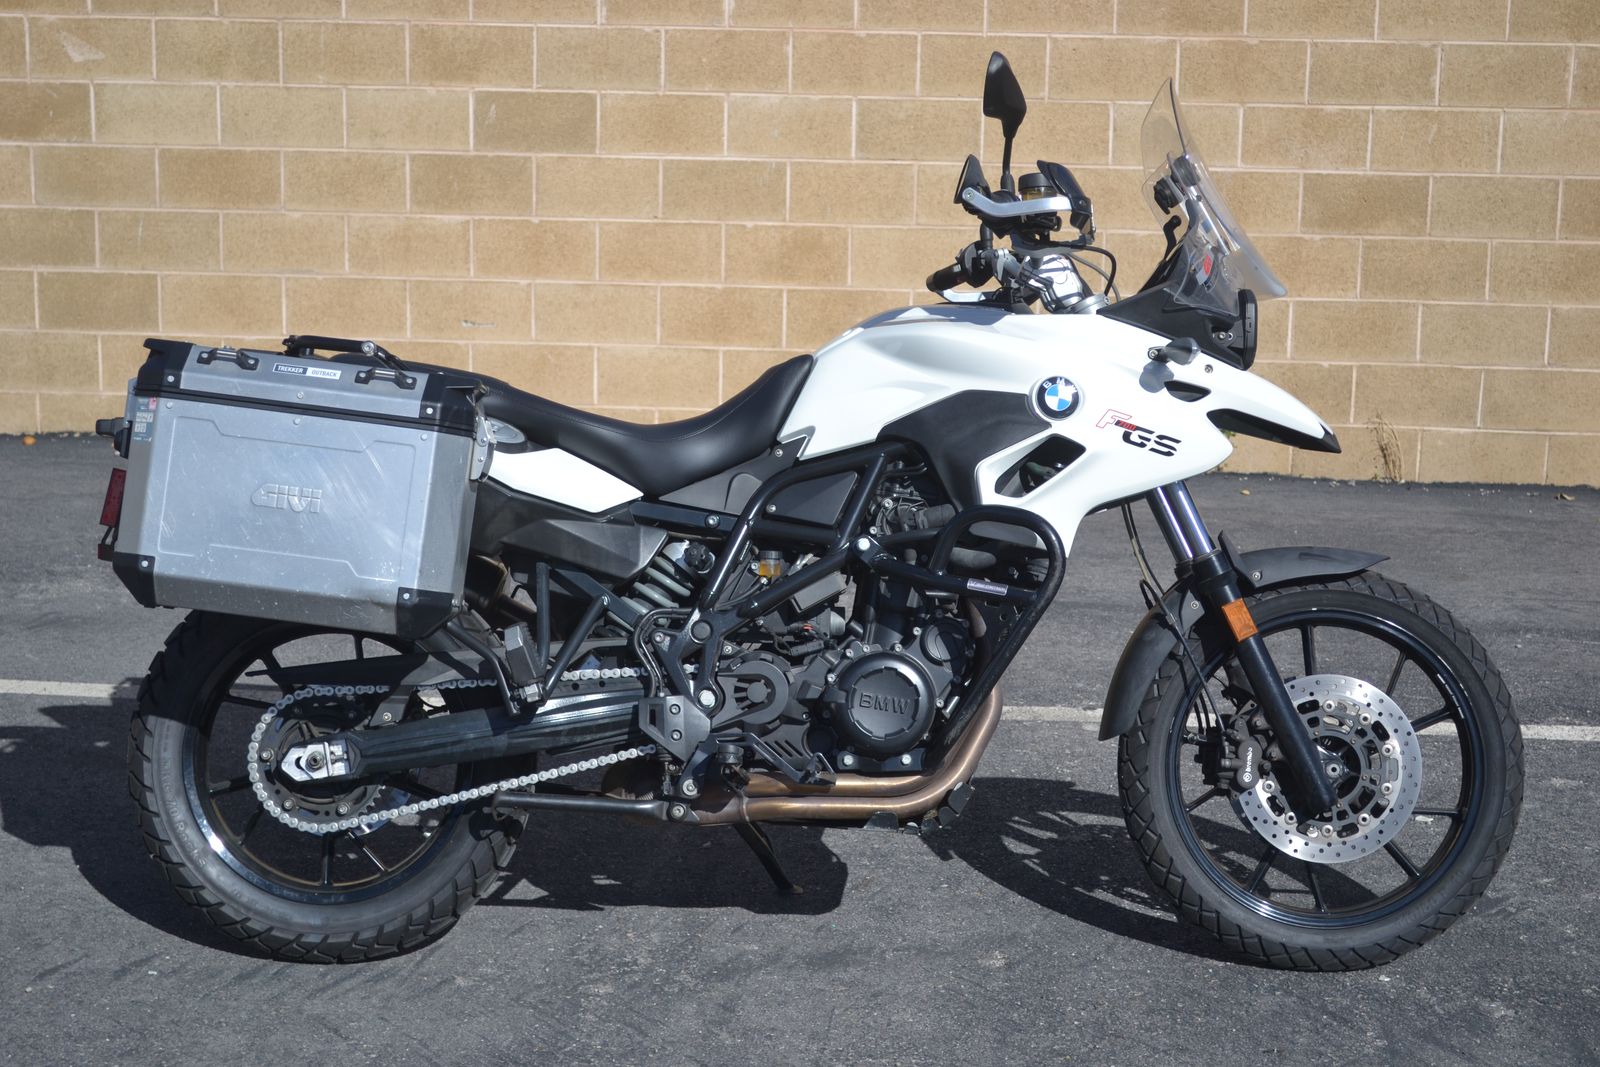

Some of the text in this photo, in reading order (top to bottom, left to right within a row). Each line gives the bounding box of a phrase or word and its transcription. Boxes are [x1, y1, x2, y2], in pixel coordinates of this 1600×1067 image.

[277, 365, 337, 377] TREKKER OUTBACK
[1096, 409, 1132, 428] F
[1121, 424, 1182, 457] GS
[251, 483, 322, 513] GIVI
[859, 692, 911, 715] BMW
